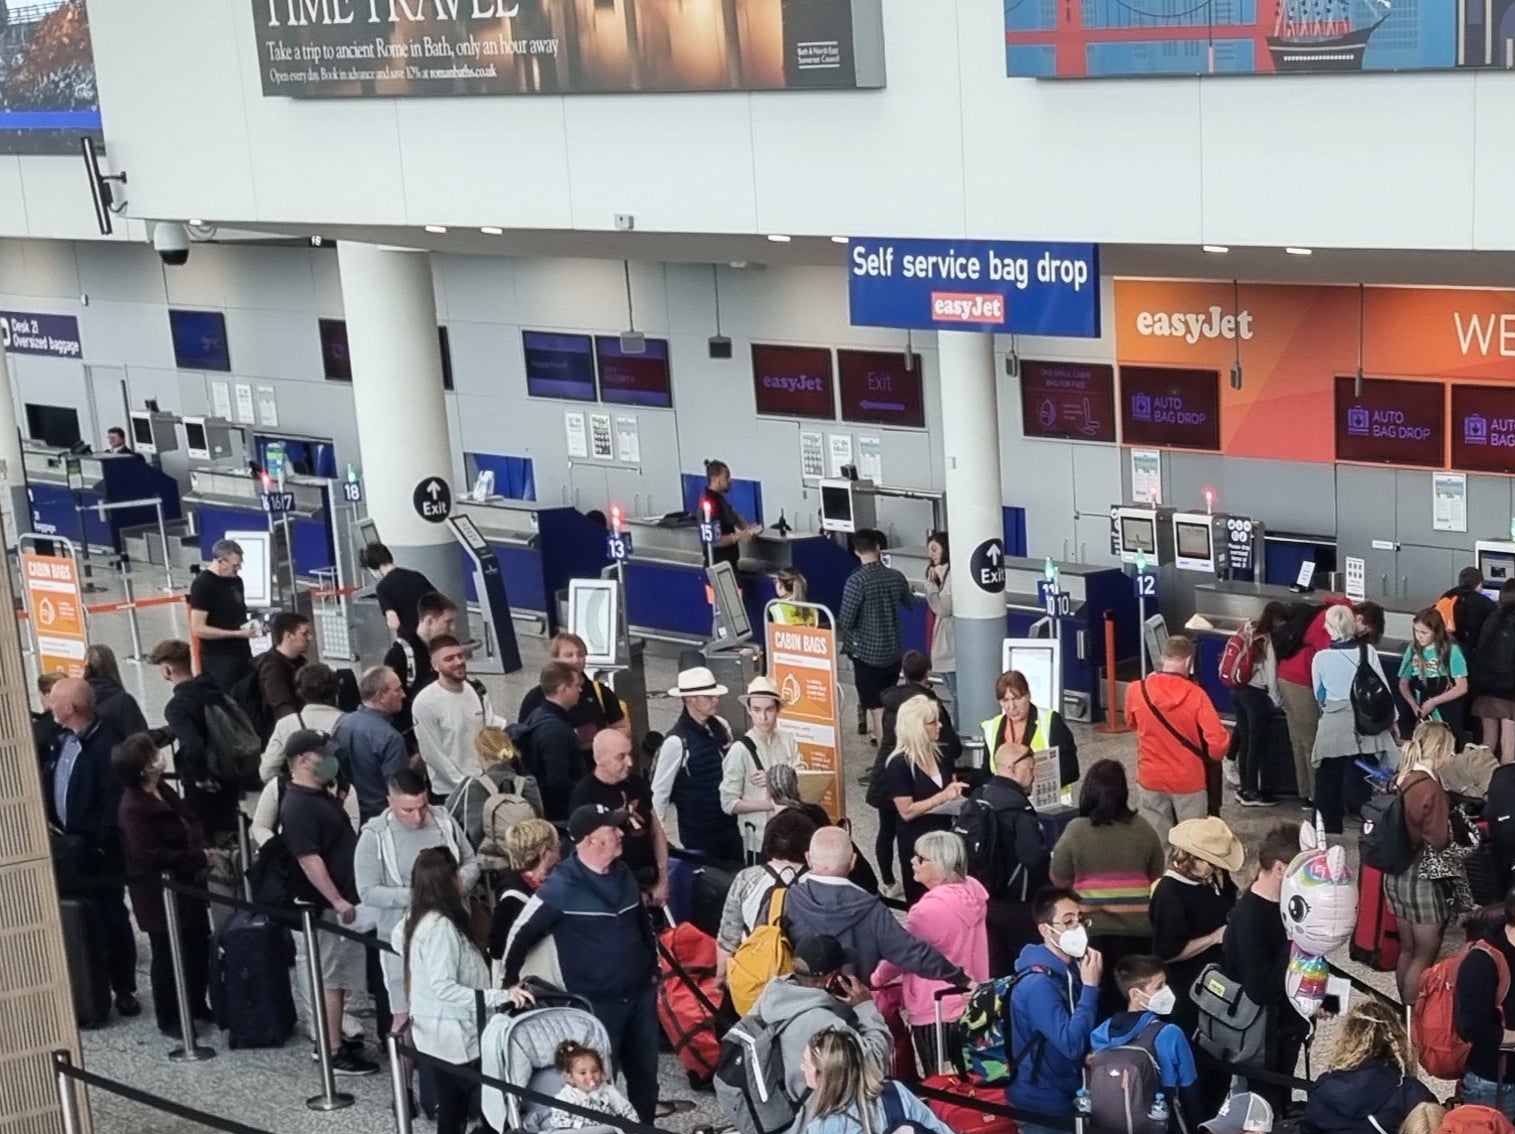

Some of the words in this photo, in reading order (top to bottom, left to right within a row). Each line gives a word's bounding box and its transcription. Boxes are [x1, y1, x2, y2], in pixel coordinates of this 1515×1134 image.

[266, 41, 292, 61] Take
[294, 47, 300, 59] a
[302, 42, 320, 64] trip
[323, 46, 334, 58] to
[336, 42, 374, 59] ancient
[376, 38, 408, 57] Rome
[410, 39, 422, 56] in
[425, 36, 454, 59] Bath,
[456, 33, 480, 56] only
[483, 41, 497, 55] an
[499, 33, 527, 55] hour
[530, 37, 559, 58] away
[853, 246, 893, 277] Self
[903, 249, 980, 279] service
[989, 250, 1028, 289] bag
[1037, 252, 1088, 291] drop
[935, 296, 1001, 320] easyJet
[11, 317, 30, 334] Desk
[1136, 306, 1253, 344] easyJet
[12, 333, 48, 350] Oversized
[48, 336, 79, 355] baggage
[763, 374, 824, 392] easyJet
[867, 372, 892, 391] Exit
[1153, 397, 1182, 409] AUTO
[1154, 411, 1175, 423] BAG
[1177, 413, 1206, 424] DROP
[1373, 411, 1404, 424] AUTO
[1373, 425, 1397, 438] BAG
[1400, 427, 1431, 440] DROP
[1491, 435, 1515, 447] BAG
[344, 484, 360, 500] 18
[422, 501, 448, 516] Exit
[701, 523, 713, 541] 15
[608, 539, 625, 558] 13
[28, 560, 51, 577] CABIN
[51, 563, 71, 580] BAGS
[981, 567, 1004, 584] Exit
[1137, 576, 1155, 594] 12
[1057, 595, 1070, 615] 10
[774, 631, 801, 651] CABIN
[803, 635, 827, 655] BAGS
